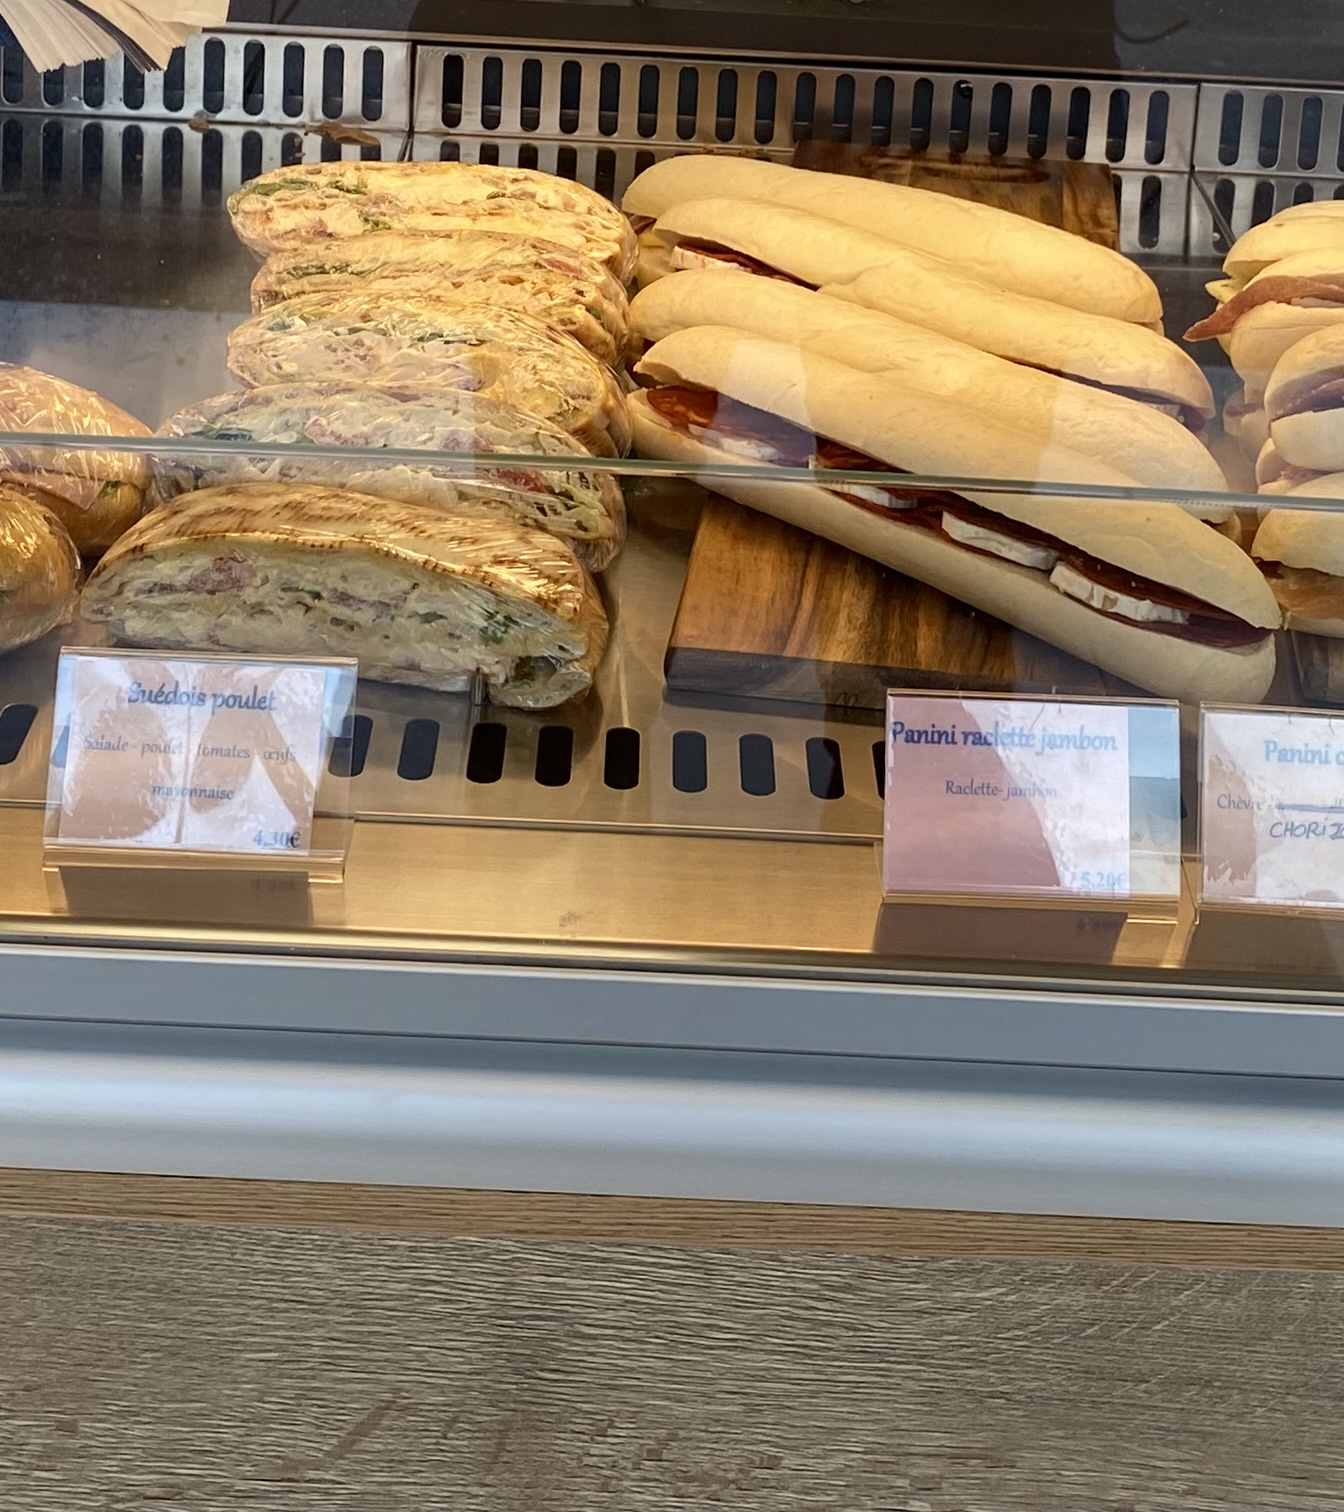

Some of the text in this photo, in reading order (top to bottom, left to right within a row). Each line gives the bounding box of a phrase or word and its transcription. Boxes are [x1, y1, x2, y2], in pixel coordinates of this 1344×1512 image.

[127, 681, 278, 715] Suédois poulet
[84, 734, 129, 752] Salade
[140, 739, 185, 757] poulet
[197, 741, 251, 760] tomates
[892, 720, 1119, 756] Panini raclette jambon
[1263, 739, 1331, 764] Panini
[151, 783, 236, 802] mayonnaise
[1003, 779, 1058, 801] jambon
[1080, 870, 1128, 890] 5,20€
